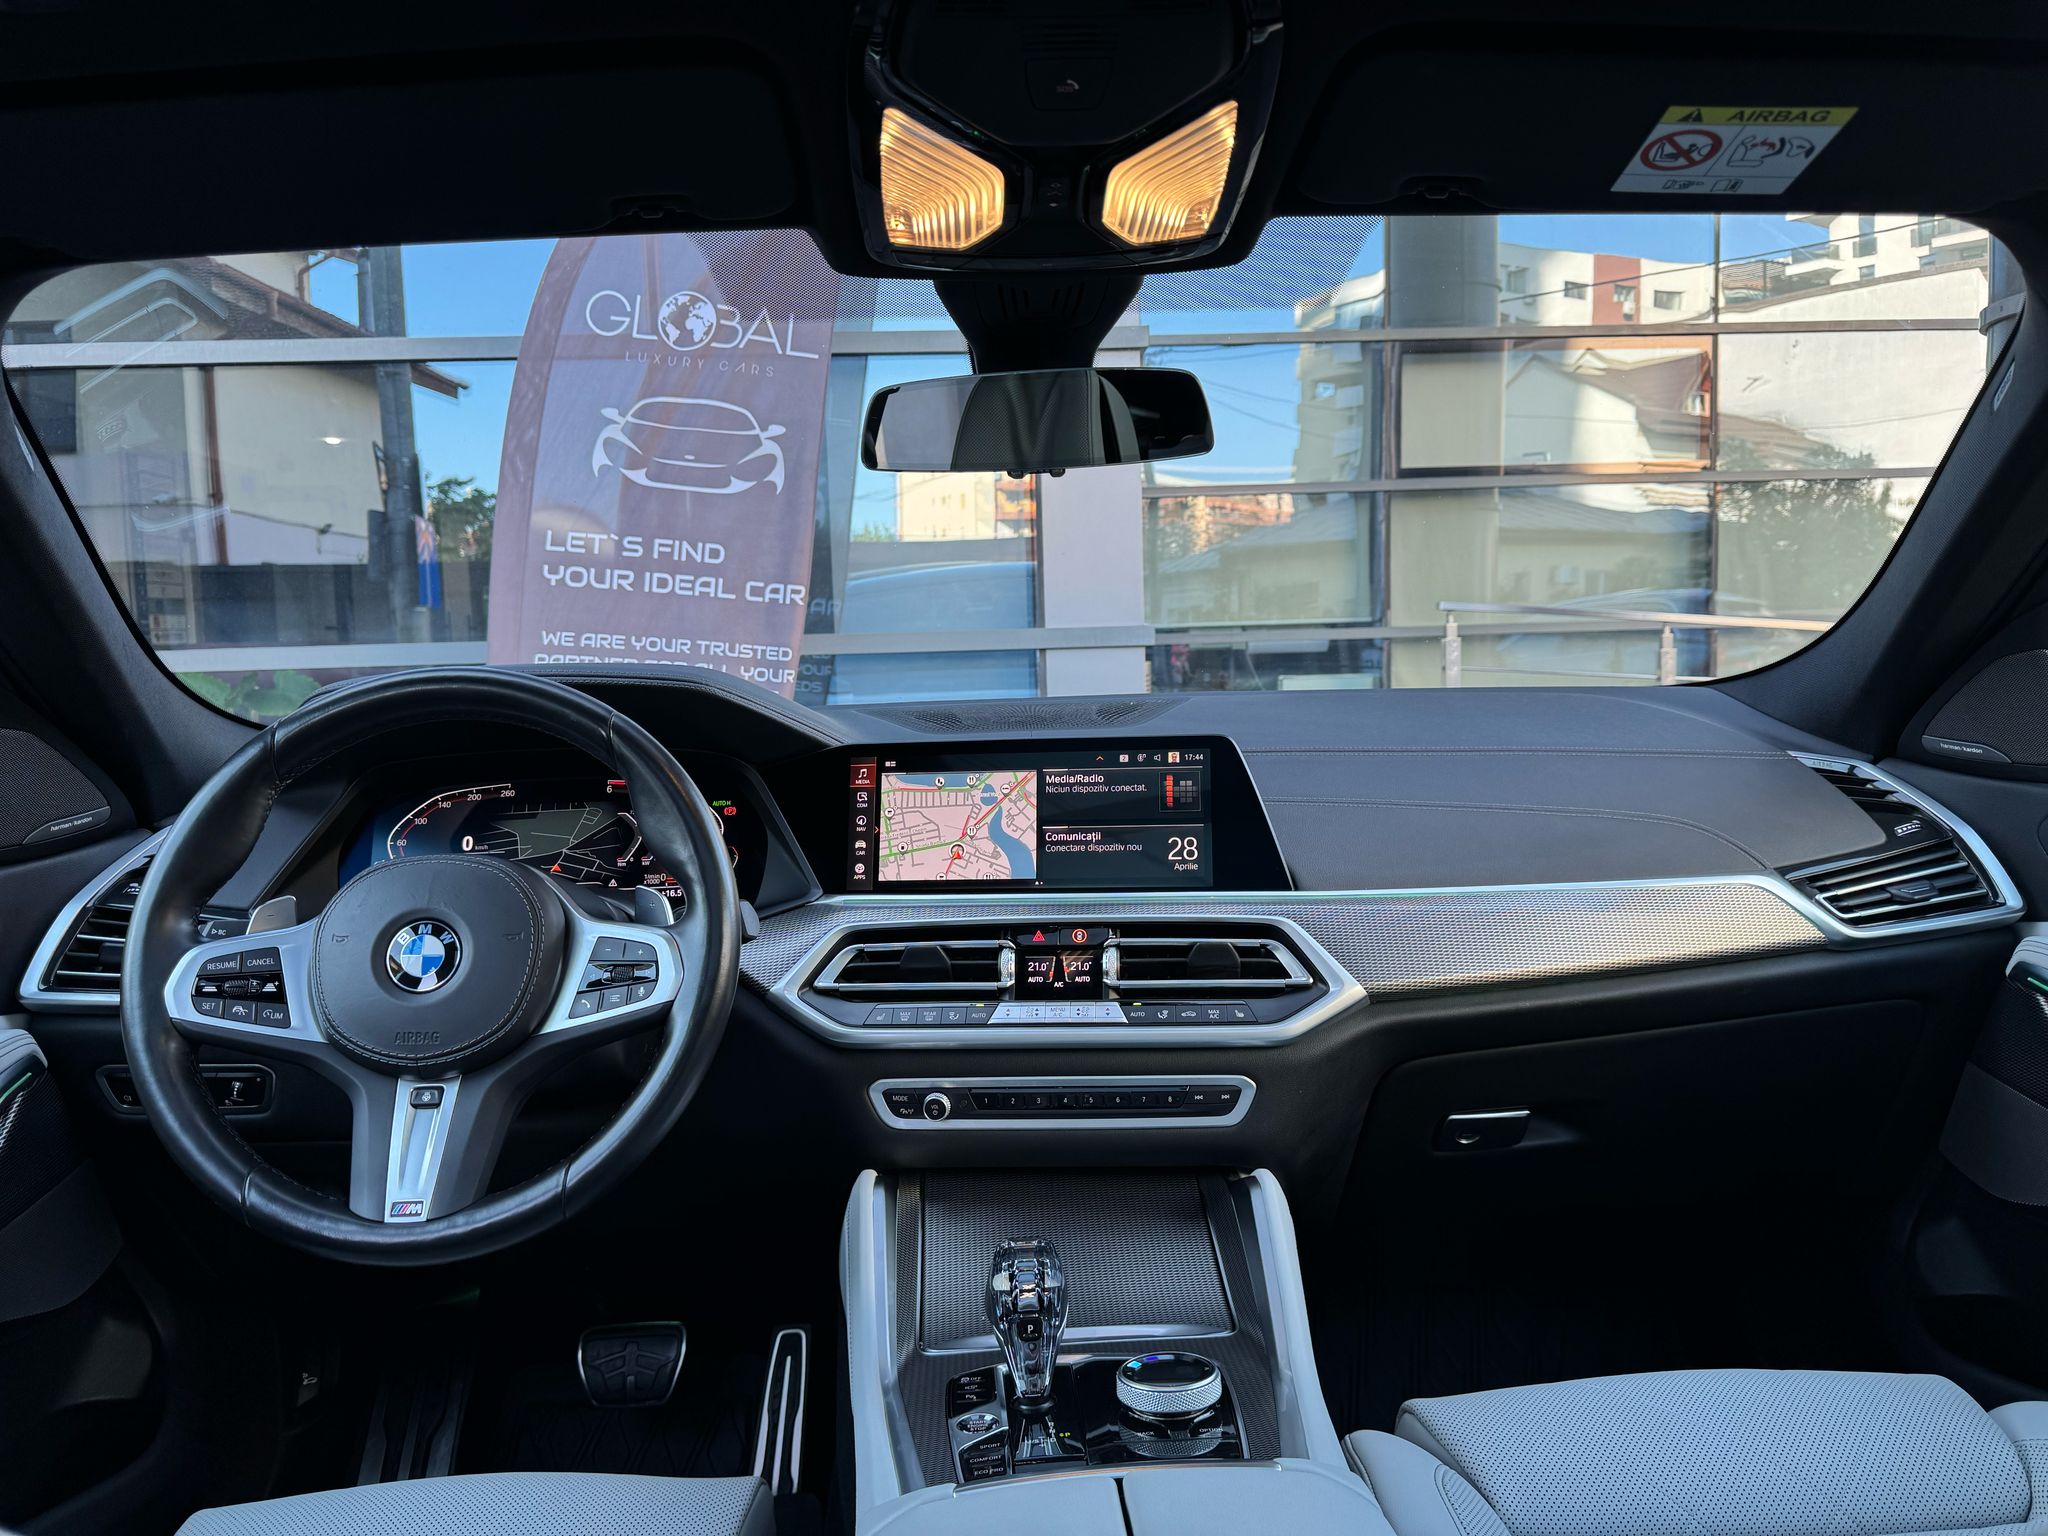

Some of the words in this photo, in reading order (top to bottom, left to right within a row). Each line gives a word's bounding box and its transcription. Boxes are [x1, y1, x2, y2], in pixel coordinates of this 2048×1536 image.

[1726, 110, 1832, 123] AIRBAG
[586, 290, 819, 359] GLOBAL
[625, 351, 705, 369] LUXURY
[719, 360, 775, 378] CARS
[653, 538, 726, 564] FIND
[543, 564, 634, 592] YOUR
[643, 571, 736, 600] IDEAL
[745, 581, 806, 606] CAR
[541, 630, 576, 647] WE
[580, 632, 626, 649] ARE
[631, 635, 692, 654] YOUR
[696, 640, 793, 662] TRUSTED
[740, 664, 796, 684] YOUR
[1184, 753, 1204, 761] 17:44
[1045, 774, 1104, 784] Media/Radio
[500, 789, 516, 798] 260
[606, 785, 613, 794] 6
[1045, 785, 1070, 794] Niciun
[1072, 784, 1109, 795] dispozitiv
[1110, 783, 1148, 793] conectat.
[467, 793, 482, 801] 200
[438, 801, 452, 809] 140
[413, 817, 428, 825] 100
[396, 839, 407, 847] 60
[462, 835, 474, 851] 0
[1045, 844, 1086, 853] Conectare
[1087, 842, 1125, 853] dispozitiv
[1126, 844, 1143, 852] nou
[1167, 836, 1199, 861] 28
[1173, 862, 1199, 872] Aprilie
[660, 873, 667, 882] 0
[396, 923, 455, 946] BMW
[207, 960, 237, 971] RESUME
[247, 957, 275, 967] CANCEL
[1074, 975, 1091, 983] AUTO
[202, 1002, 216, 1010] SET
[271, 1011, 284, 1019] LIM
[394, 1031, 440, 1046] AIRBAG
[1027, 1324, 1034, 1334] P
[979, 1442, 1001, 1450] SPORT
[969, 1454, 1002, 1463] COMFORT
